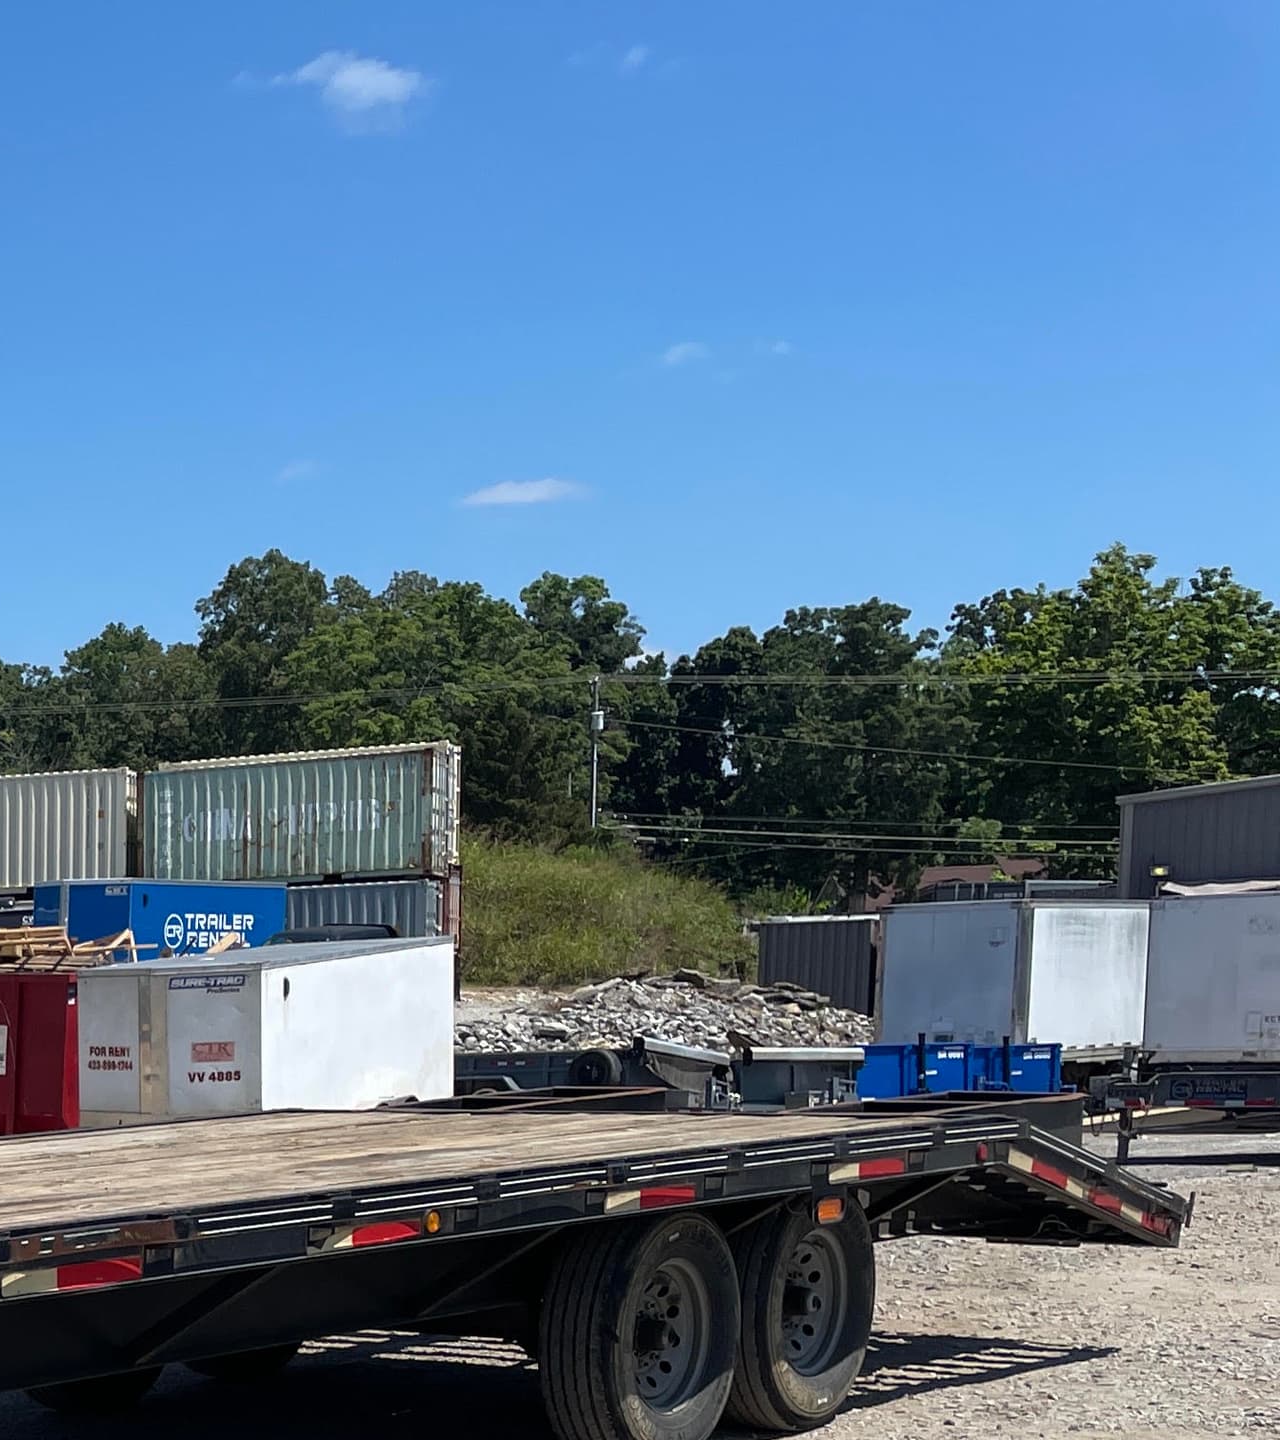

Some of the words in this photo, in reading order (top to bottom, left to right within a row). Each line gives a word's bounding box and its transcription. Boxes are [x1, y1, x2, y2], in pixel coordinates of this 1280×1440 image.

[185, 914, 254, 930] TRAILER
[170, 975, 244, 990] SURE-TRAC
[89, 1046, 107, 1057] FOR
[109, 1046, 130, 1058] RENT
[188, 1072, 205, 1083] VV
